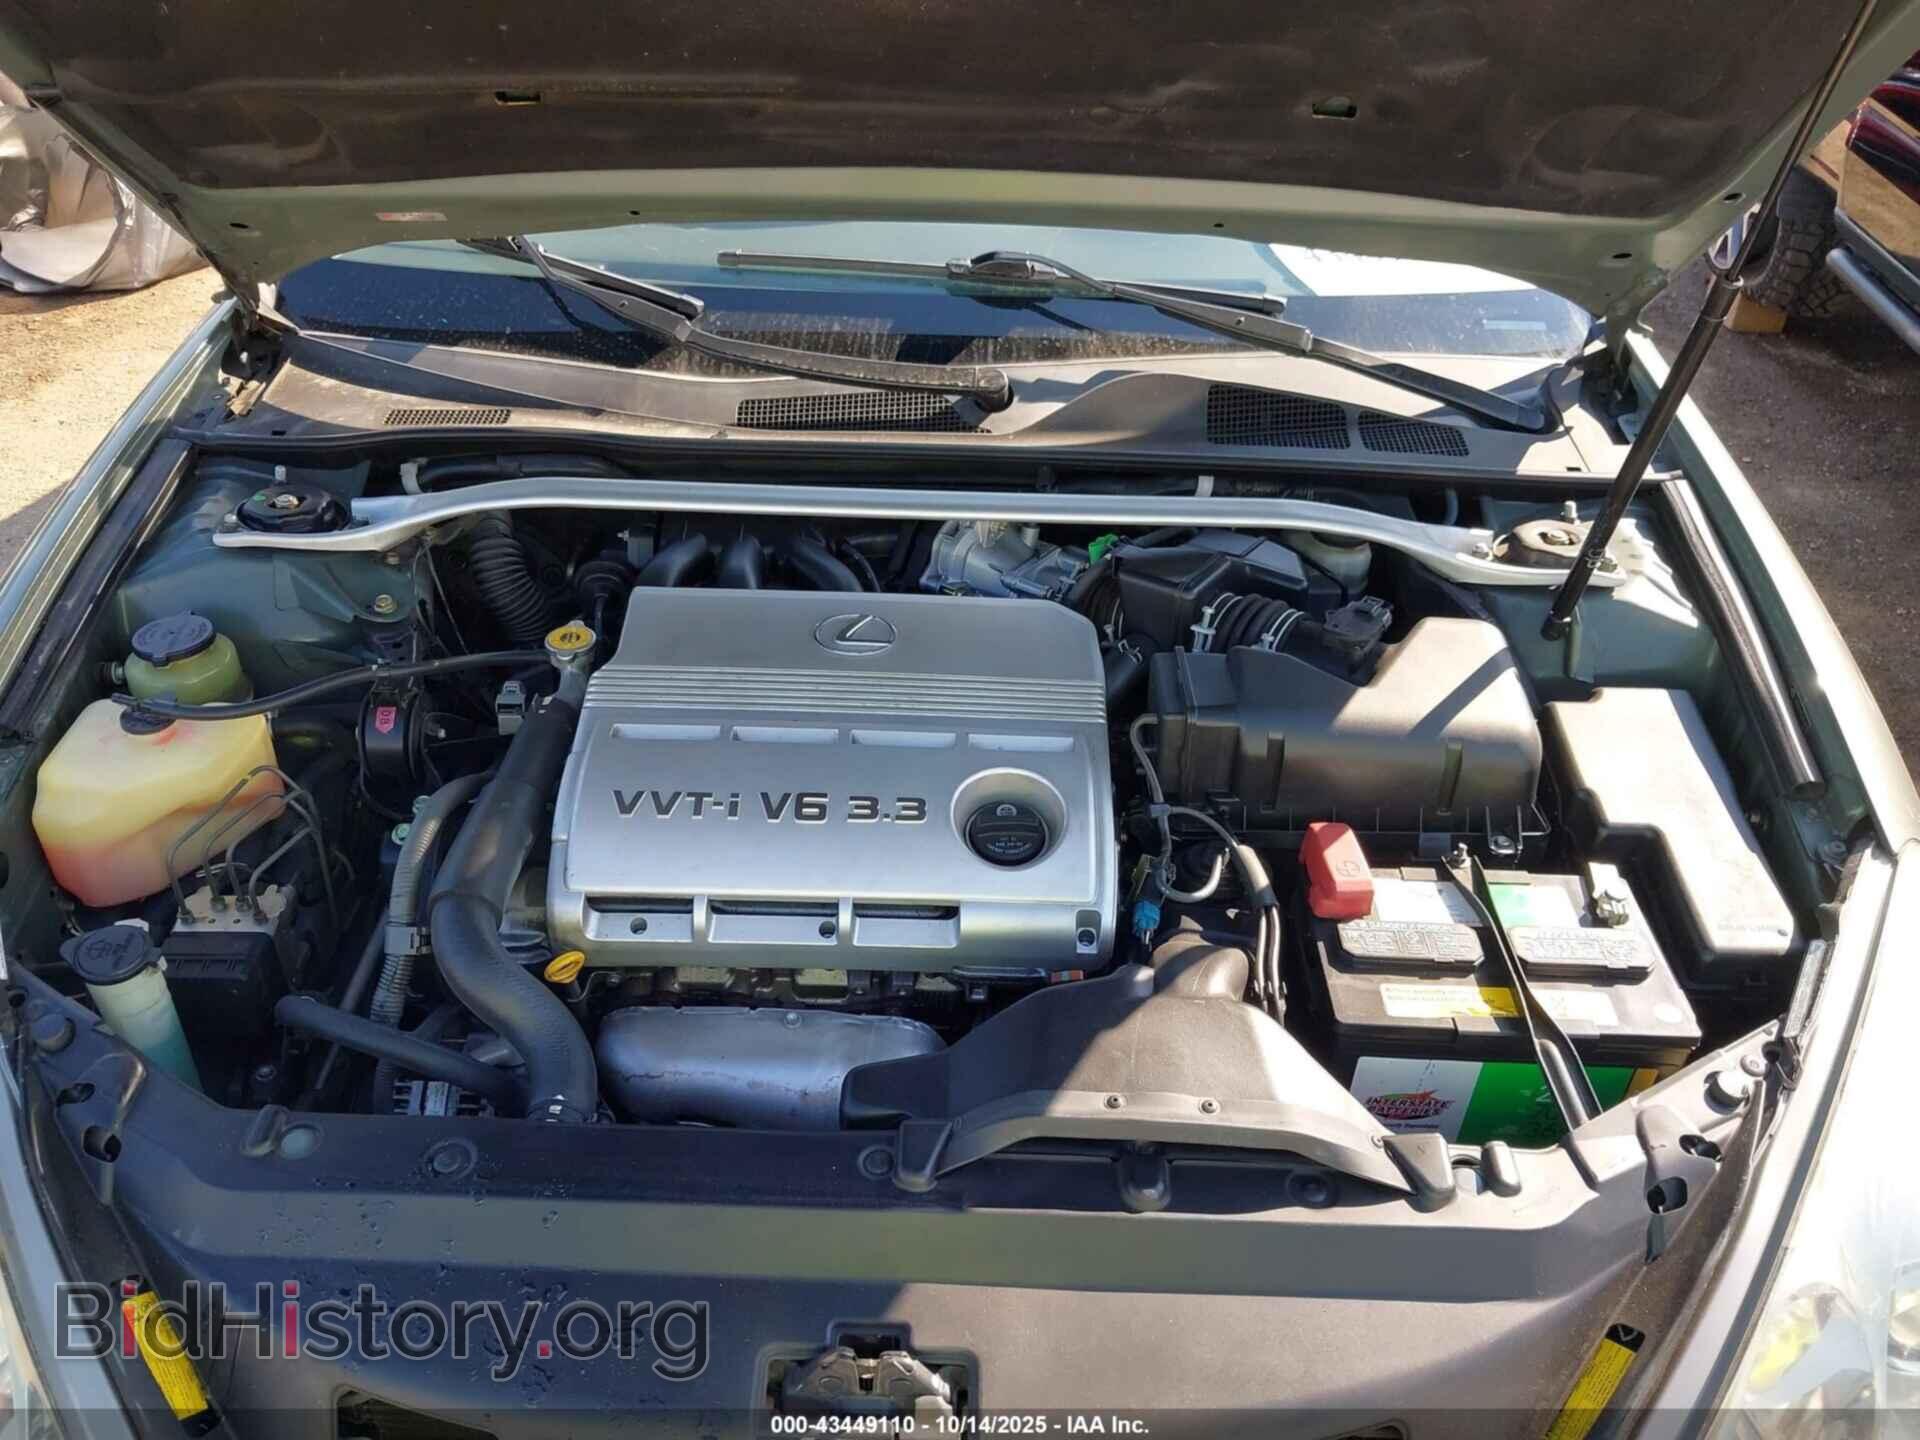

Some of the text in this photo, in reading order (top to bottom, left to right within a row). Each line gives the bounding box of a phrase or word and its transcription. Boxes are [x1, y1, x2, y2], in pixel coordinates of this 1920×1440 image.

[612, 789, 928, 825] VVT-i V6 3.3
[1365, 1095, 1448, 1110] INTERSTATE
